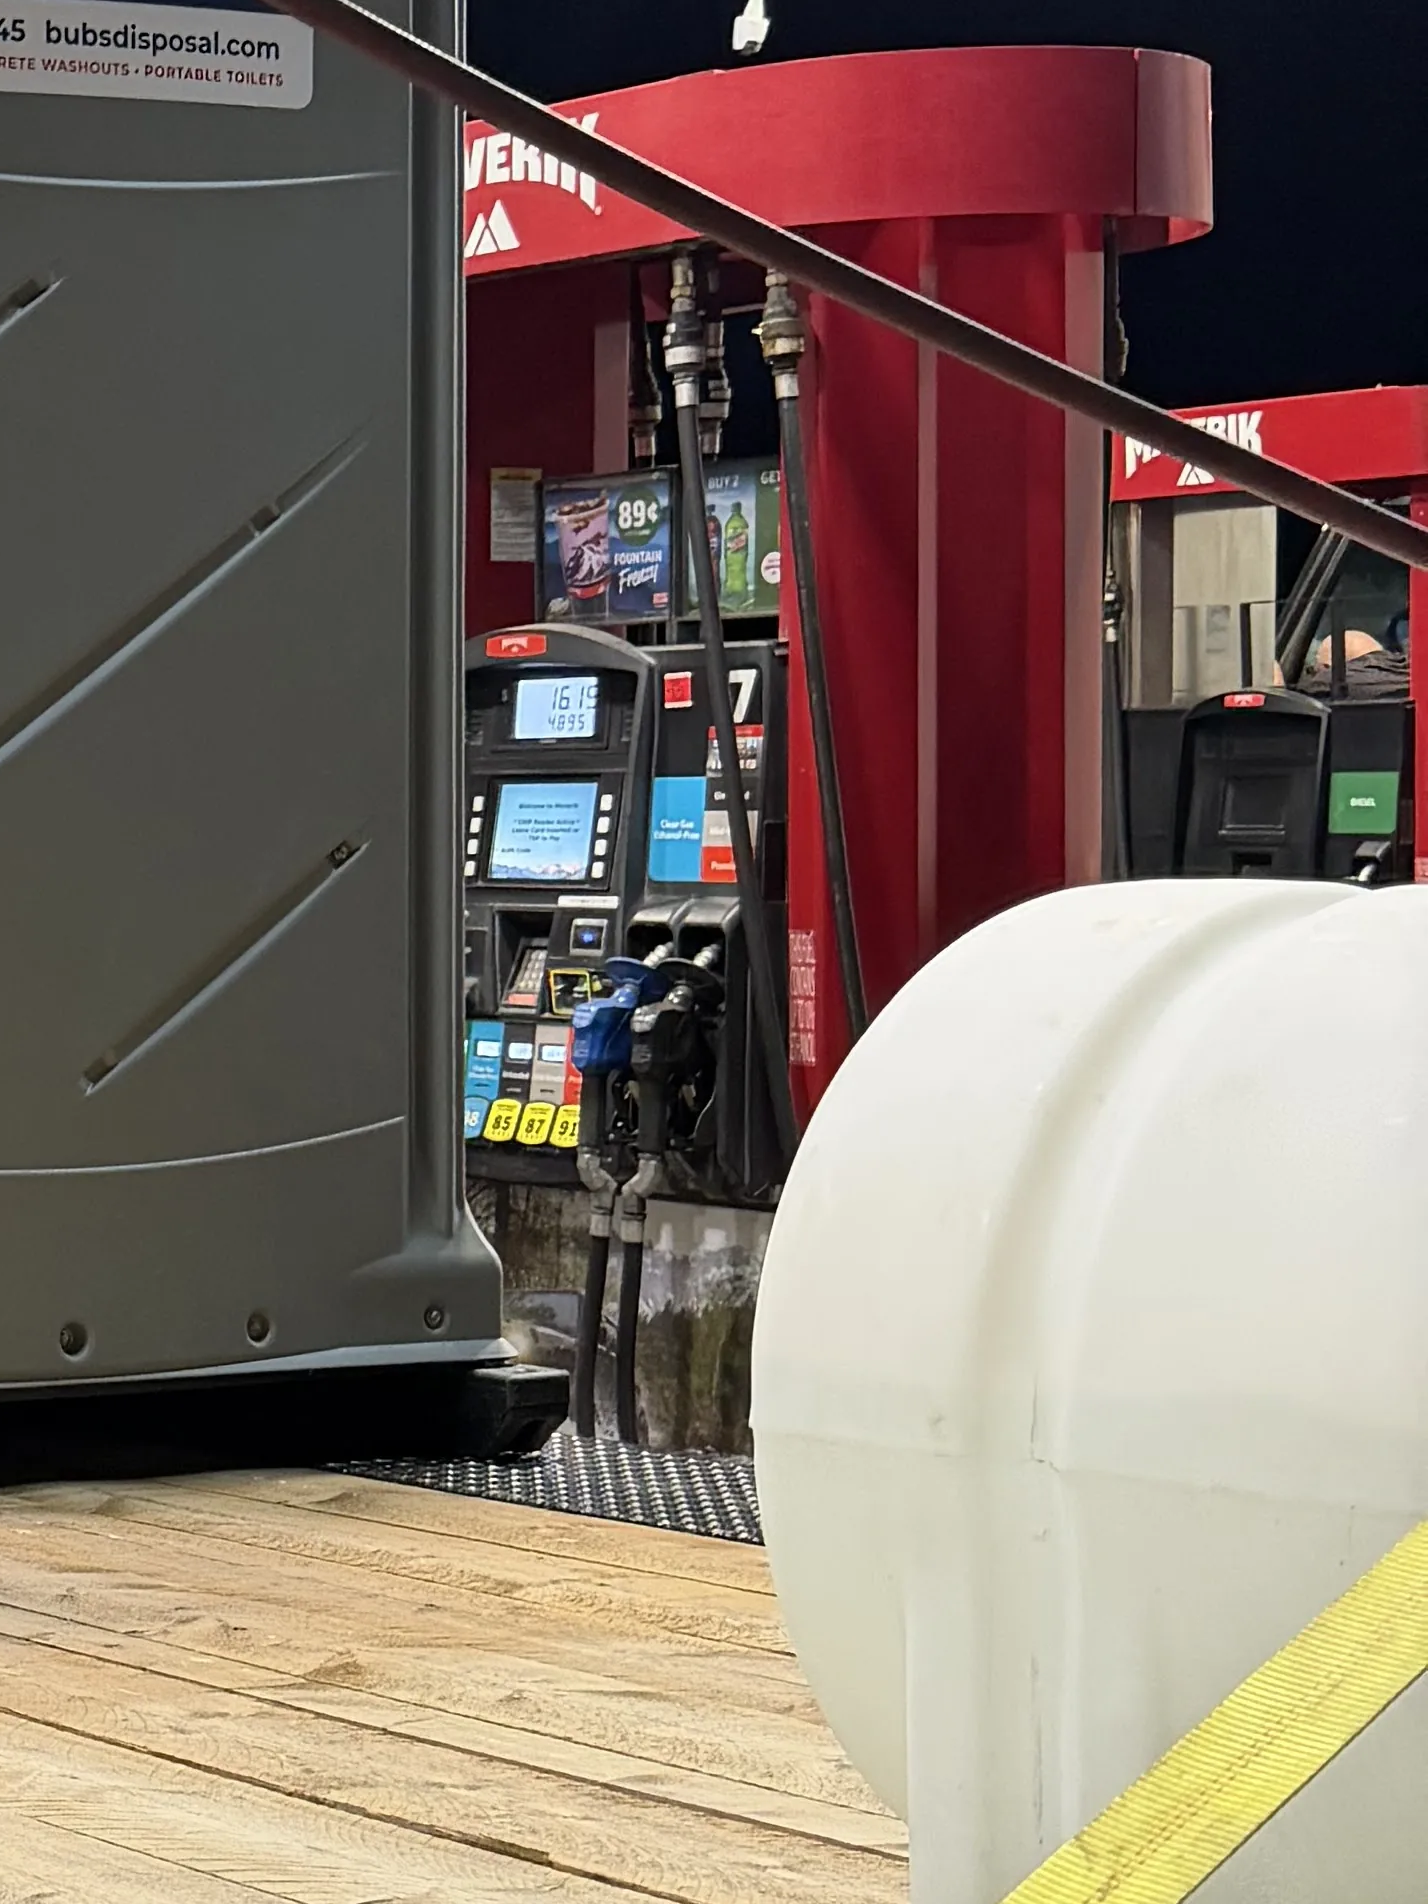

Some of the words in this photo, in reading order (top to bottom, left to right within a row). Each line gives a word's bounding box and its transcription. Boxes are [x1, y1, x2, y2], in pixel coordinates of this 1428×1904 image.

[45, 20, 280, 60] bubsdisposal.com
[41, 58, 130, 77] WASHOUTS
[144, 64, 222, 84] PORTABLE
[227, 70, 284, 87] TOILETS
[464, 112, 601, 211] VERIK
[618, 499, 659, 528] 89¢
[614, 549, 662, 566] FOUNTAIN
[729, 669, 757, 724] 7
[492, 1114, 512, 1131] 85
[525, 1118, 546, 1134] 87
